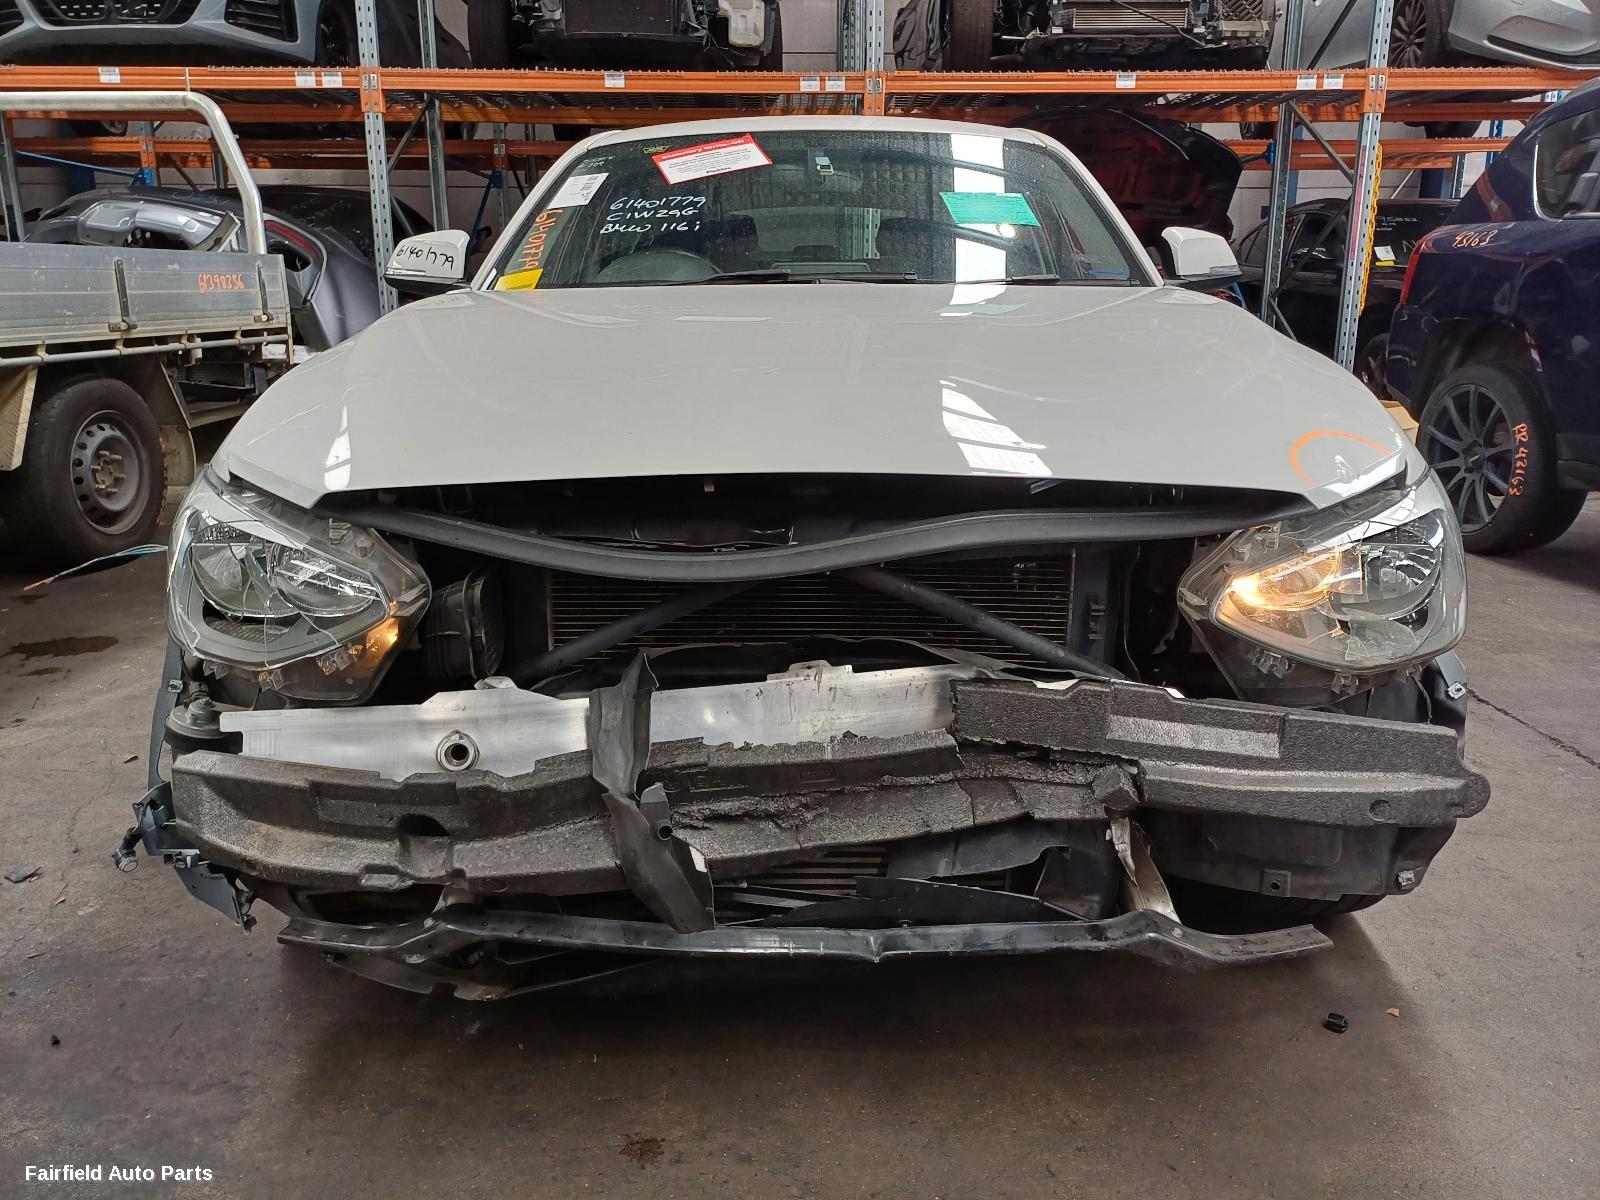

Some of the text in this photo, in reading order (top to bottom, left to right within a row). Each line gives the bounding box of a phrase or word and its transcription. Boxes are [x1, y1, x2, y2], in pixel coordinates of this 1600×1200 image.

[609, 196, 707, 210] 61401779
[600, 223, 652, 234] BMW
[518, 208, 564, 271] 61401779
[396, 244, 455, 271] 61401779
